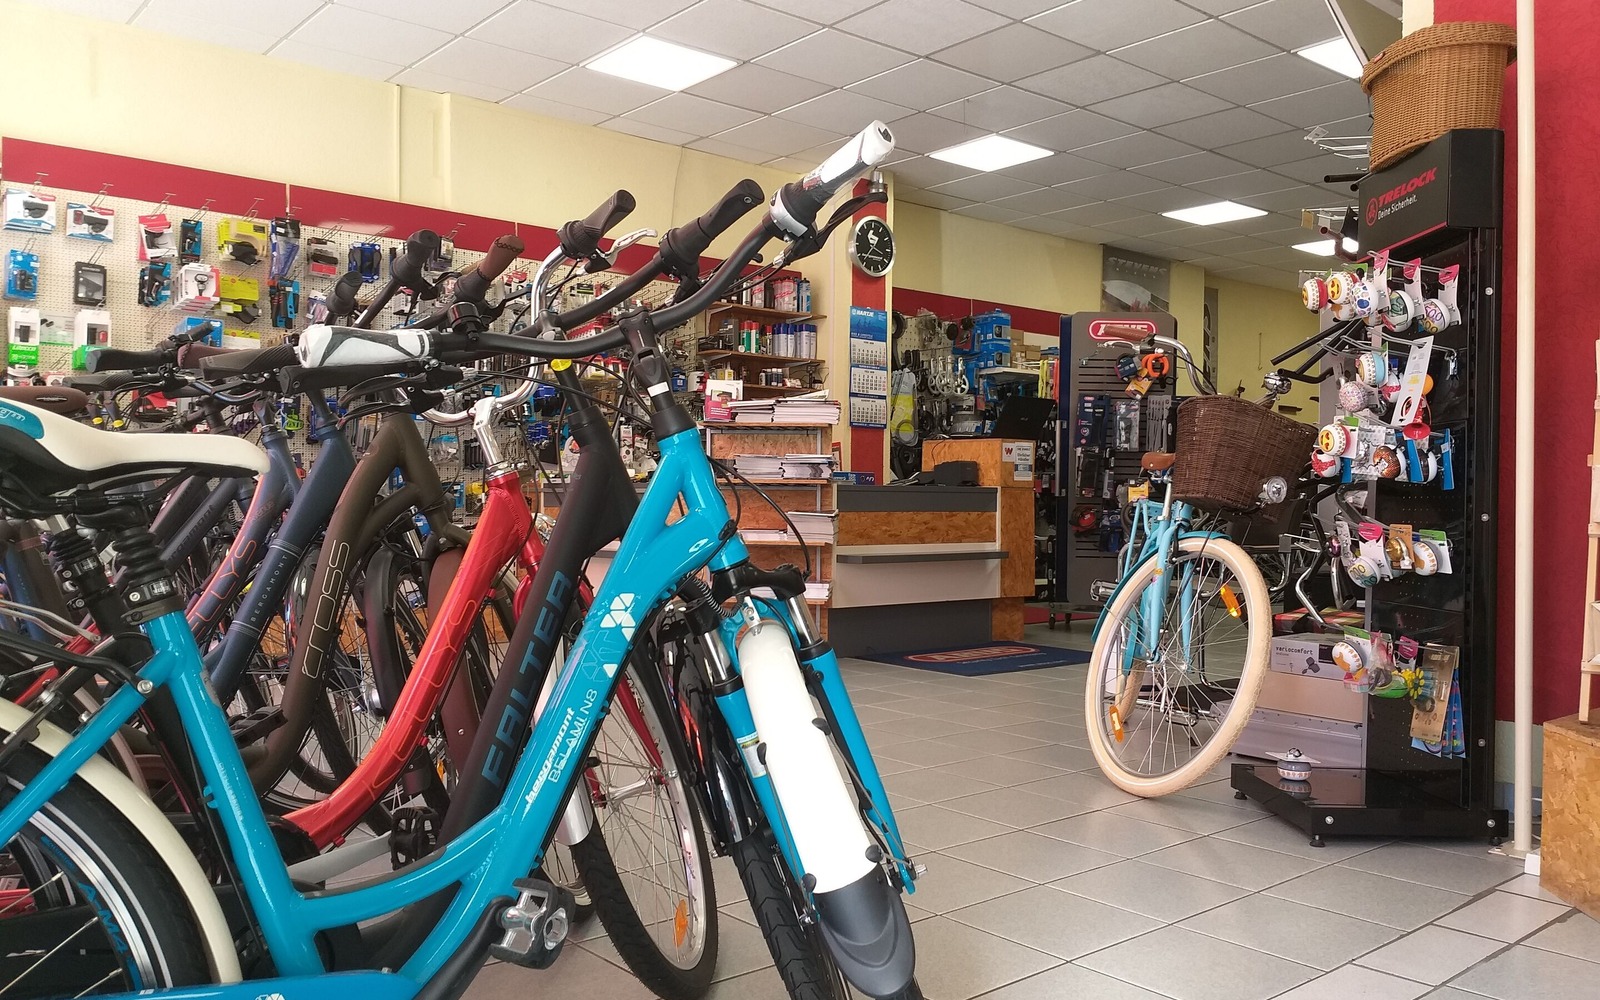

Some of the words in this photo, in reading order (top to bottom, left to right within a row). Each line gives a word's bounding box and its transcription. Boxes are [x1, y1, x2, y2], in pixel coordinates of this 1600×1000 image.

[1378, 167, 1438, 208] TRELOCK
[1378, 208, 1391, 220] Deine
[1391, 193, 1418, 214] Sicherheit.
[1108, 257, 1168, 276] STEVENS
[188, 536, 258, 641] ELLYS
[250, 553, 289, 623] BERGAMONT
[1275, 646, 1314, 655] variocomfort
[481, 570, 573, 788] FALTER
[579, 688, 598, 716] N8
[522, 706, 576, 812] bergamont
